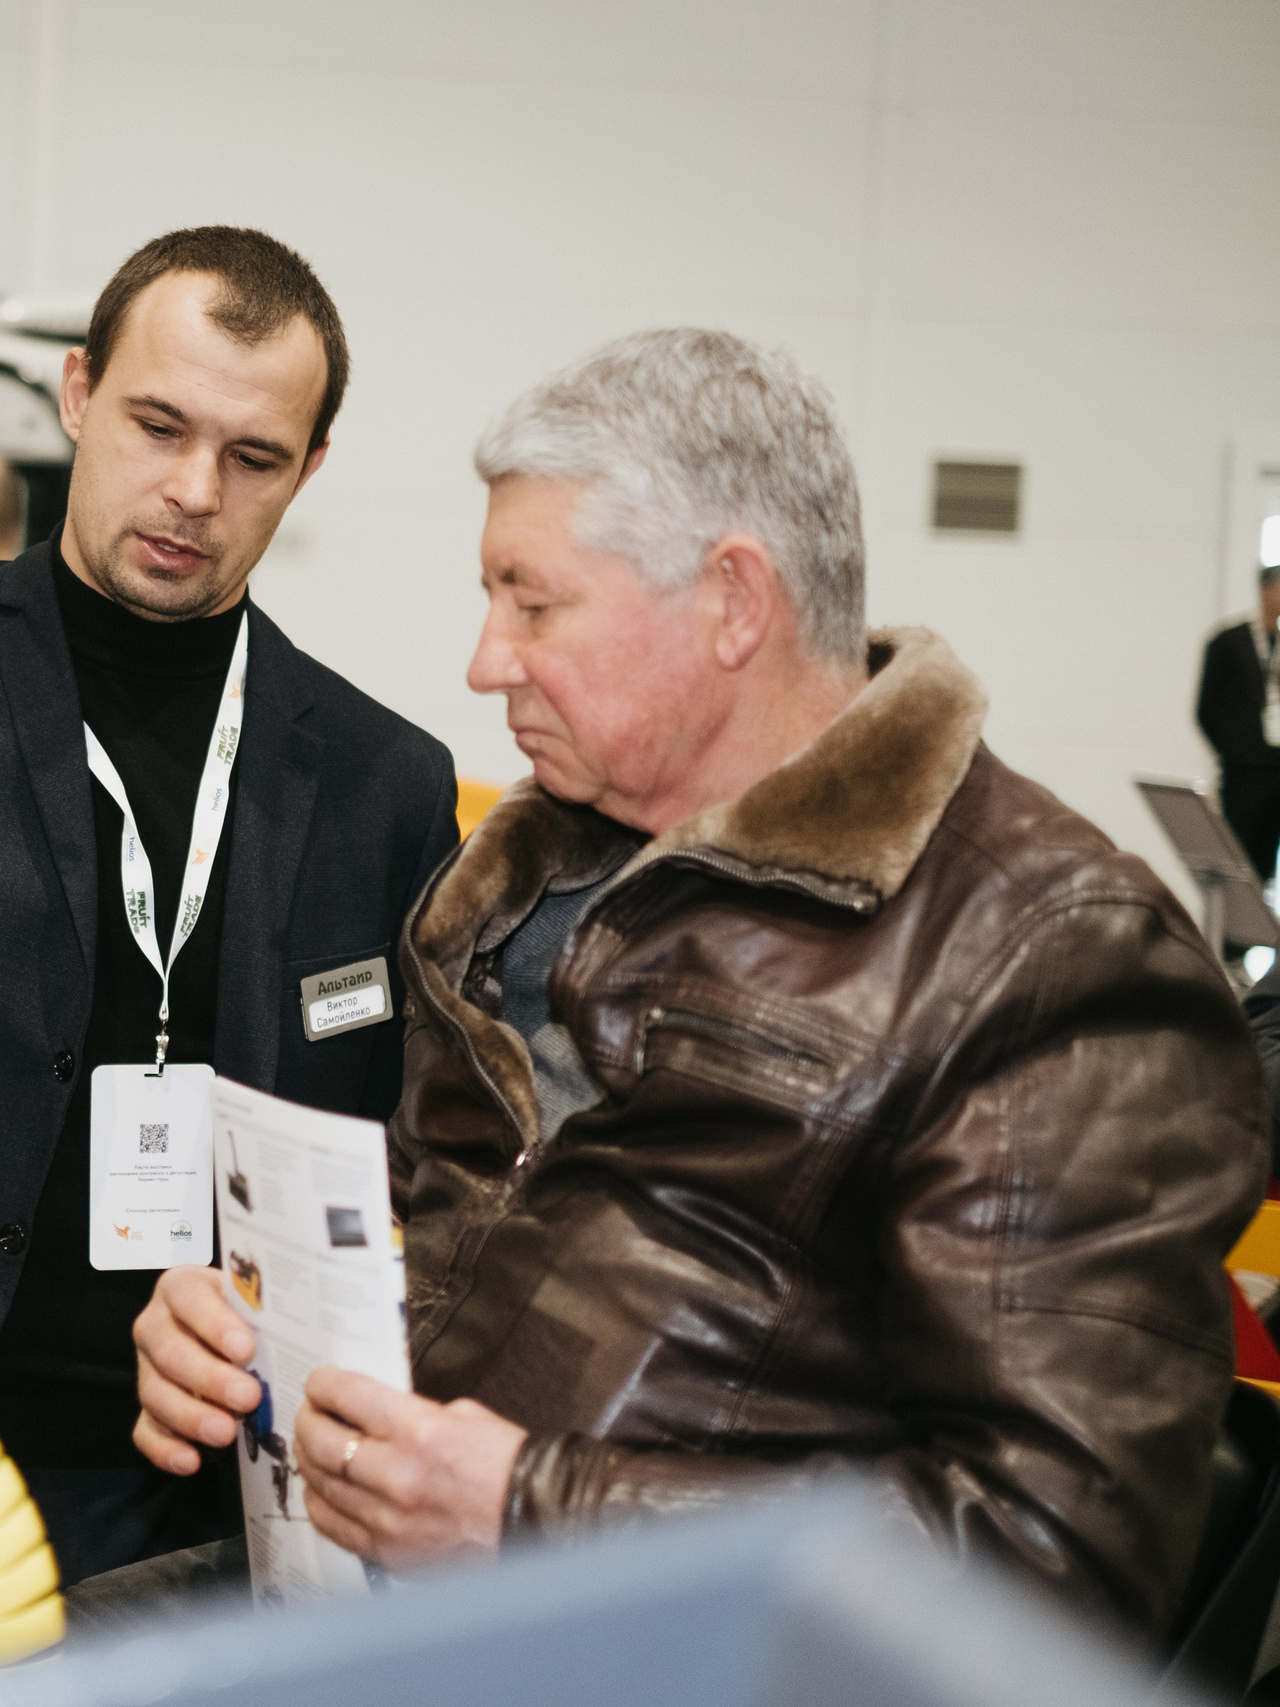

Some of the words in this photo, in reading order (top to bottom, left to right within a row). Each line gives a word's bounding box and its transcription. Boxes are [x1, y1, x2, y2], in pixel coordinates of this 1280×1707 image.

[224, 725, 239, 766] TRADE
[211, 787, 223, 812] helios
[128, 837, 136, 862] helios
[126, 888, 140, 935] TRADE
[183, 894, 202, 938] TRADE
[318, 971, 373, 996] Альтаир
[327, 997, 358, 1012] Виктор
[317, 1007, 371, 1028] Самойленко
